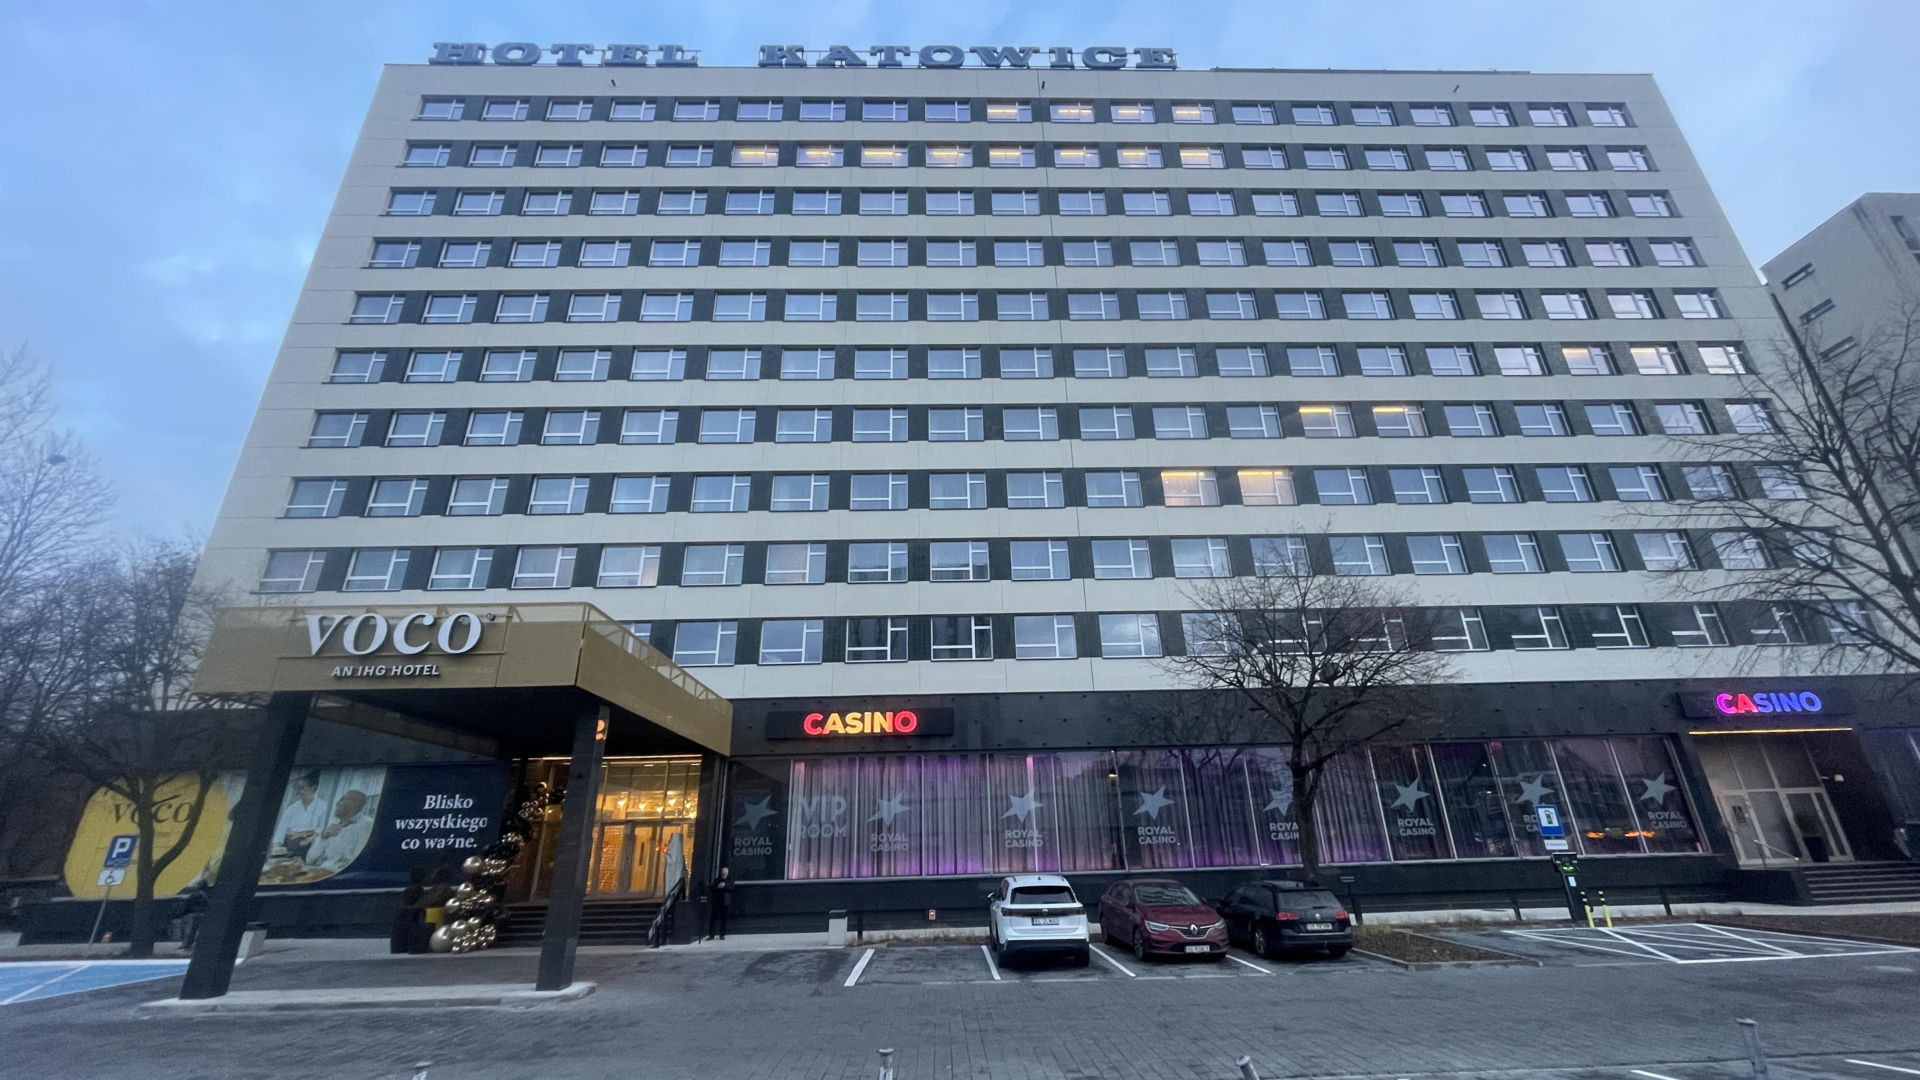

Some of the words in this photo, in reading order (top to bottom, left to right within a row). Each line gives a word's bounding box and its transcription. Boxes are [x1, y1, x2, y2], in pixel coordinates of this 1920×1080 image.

[429, 42, 698, 67] HOTEL
[758, 45, 1176, 69] KATOWICE
[331, 666, 352, 677] AN
[357, 665, 386, 676] IHG
[392, 664, 439, 676] HOTEL
[1716, 691, 1822, 714] CASINO
[803, 710, 917, 735] CASINO
[423, 794, 473, 809] Blisko
[799, 796, 847, 823] VIP
[1648, 811, 1684, 821] ROYAL
[395, 813, 488, 833] wszystkiego
[1269, 822, 1299, 832] ROYA
[1397, 817, 1433, 827] ROYAL
[1650, 821, 1687, 830] CASINO
[1005, 829, 1042, 839] ROYAL
[1138, 826, 1174, 835] ROYAL
[1271, 831, 1300, 841] CASIN
[1399, 826, 1436, 837] CASINO
[735, 836, 772, 847] ROYAL
[872, 832, 908, 843] ROYAL
[1005, 838, 1043, 848] CASINO
[1139, 836, 1176, 845] CASINO
[112, 838, 130, 858] P
[401, 838, 420, 849] co
[870, 843, 908, 852] CASINO
[733, 847, 772, 856] CASINO
